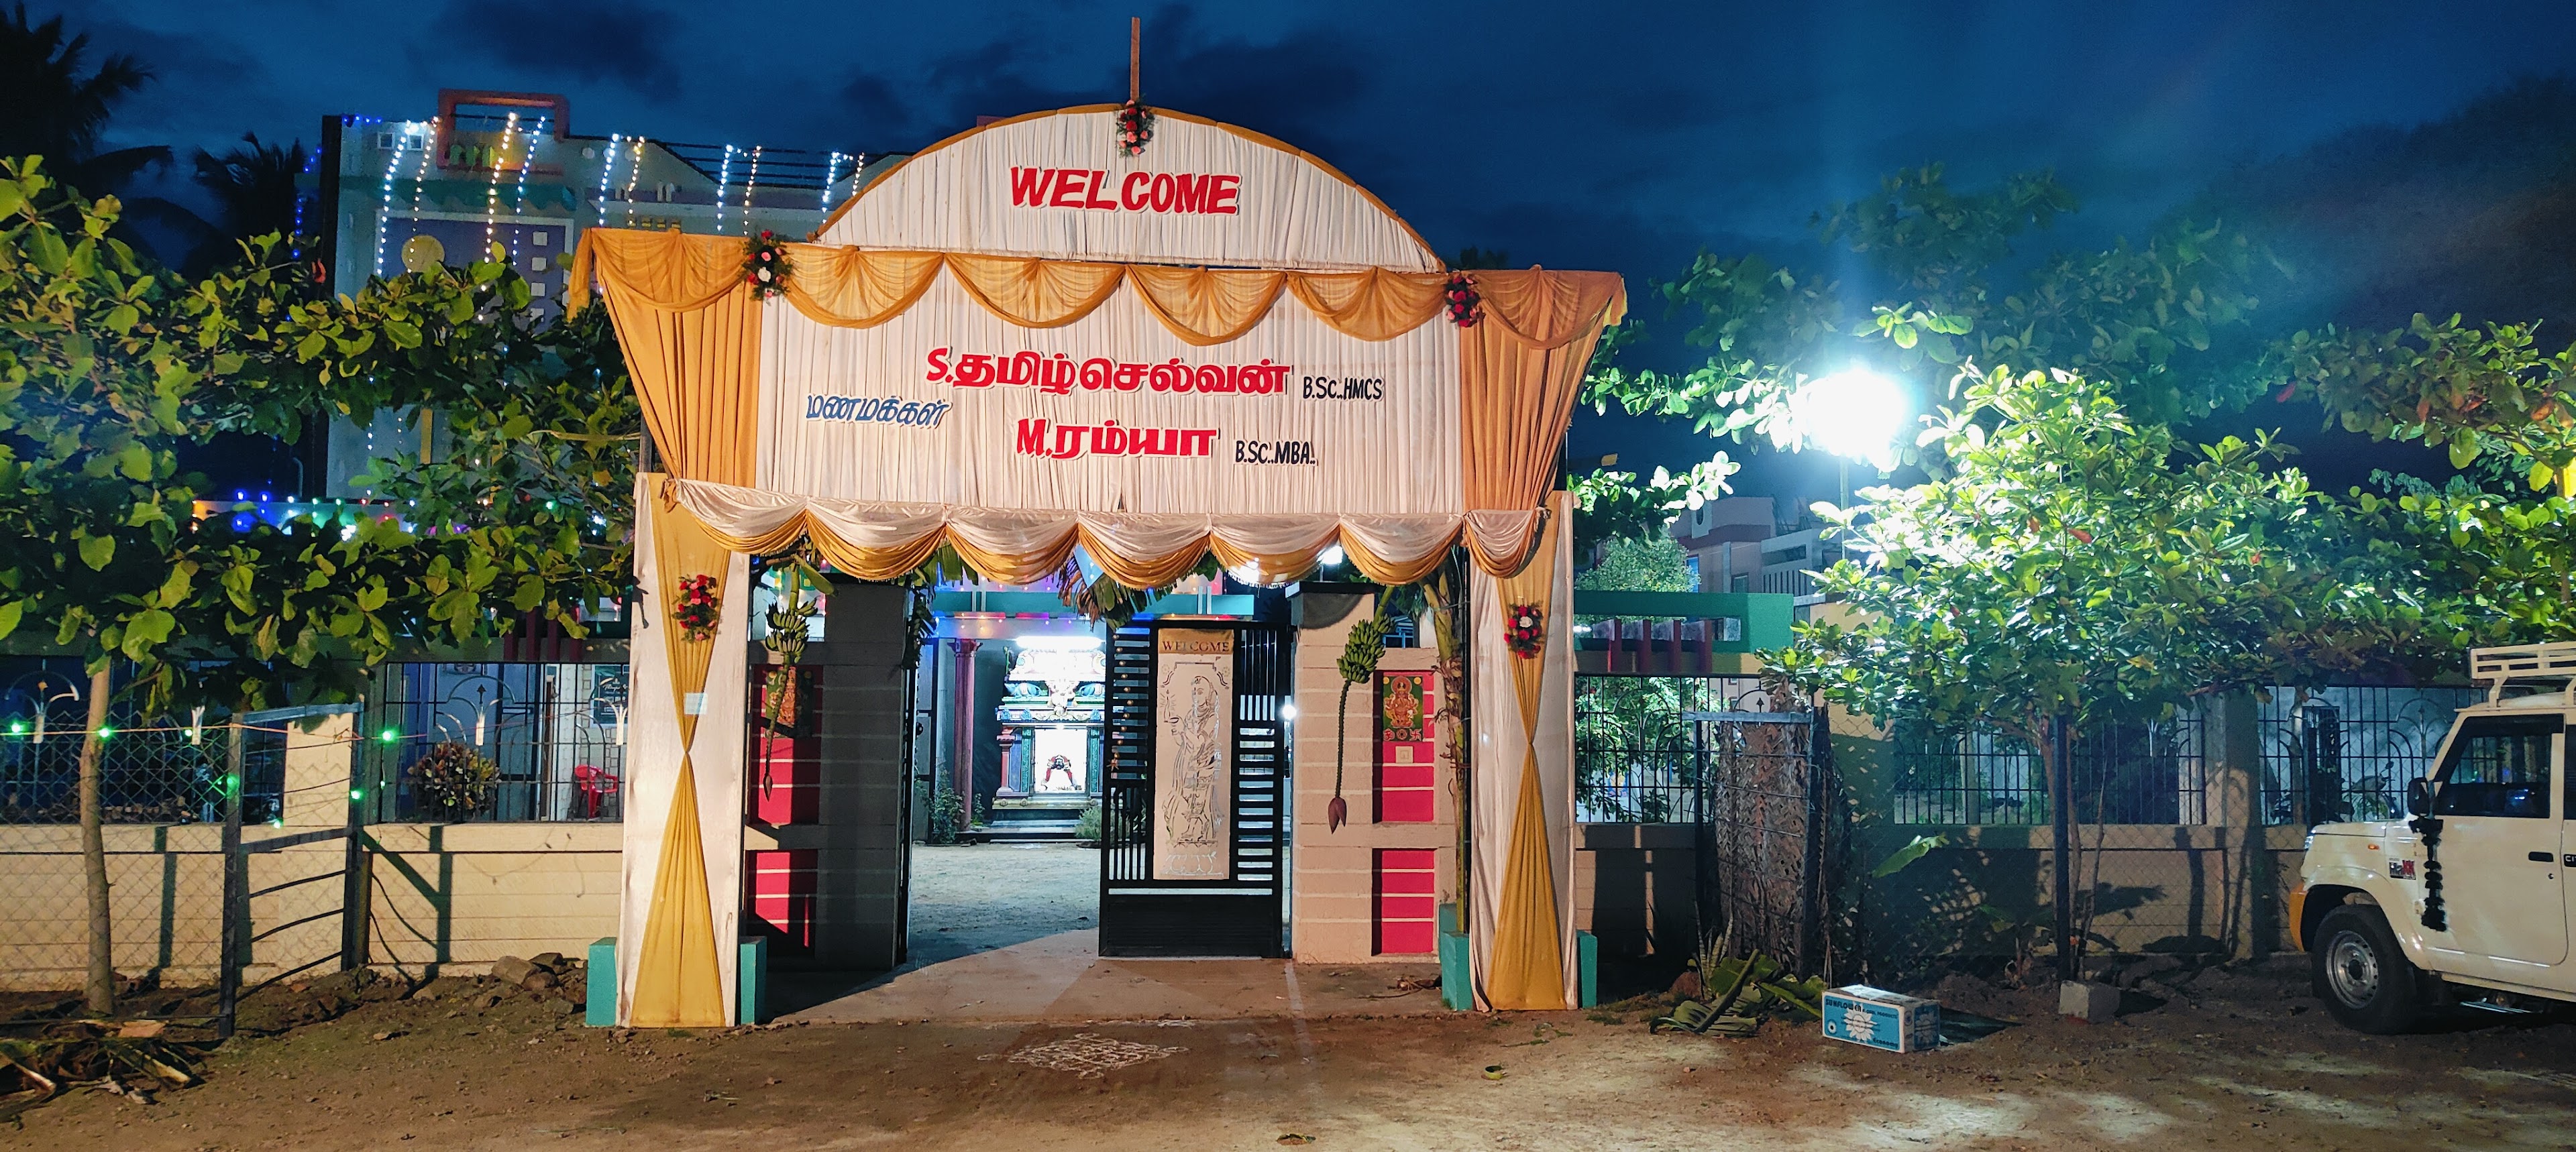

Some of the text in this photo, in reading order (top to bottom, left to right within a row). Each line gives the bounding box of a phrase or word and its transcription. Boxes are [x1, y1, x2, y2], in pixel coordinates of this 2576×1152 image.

[1010, 166, 1240, 214] WELCOME
[806, 395, 949, 426] மணமக்கள்
[1016, 418, 1217, 459] M.ரம்யா
[1163, 641, 1229, 652] WELCOME
[1825, 998, 1862, 1012] SUNFLOWER
